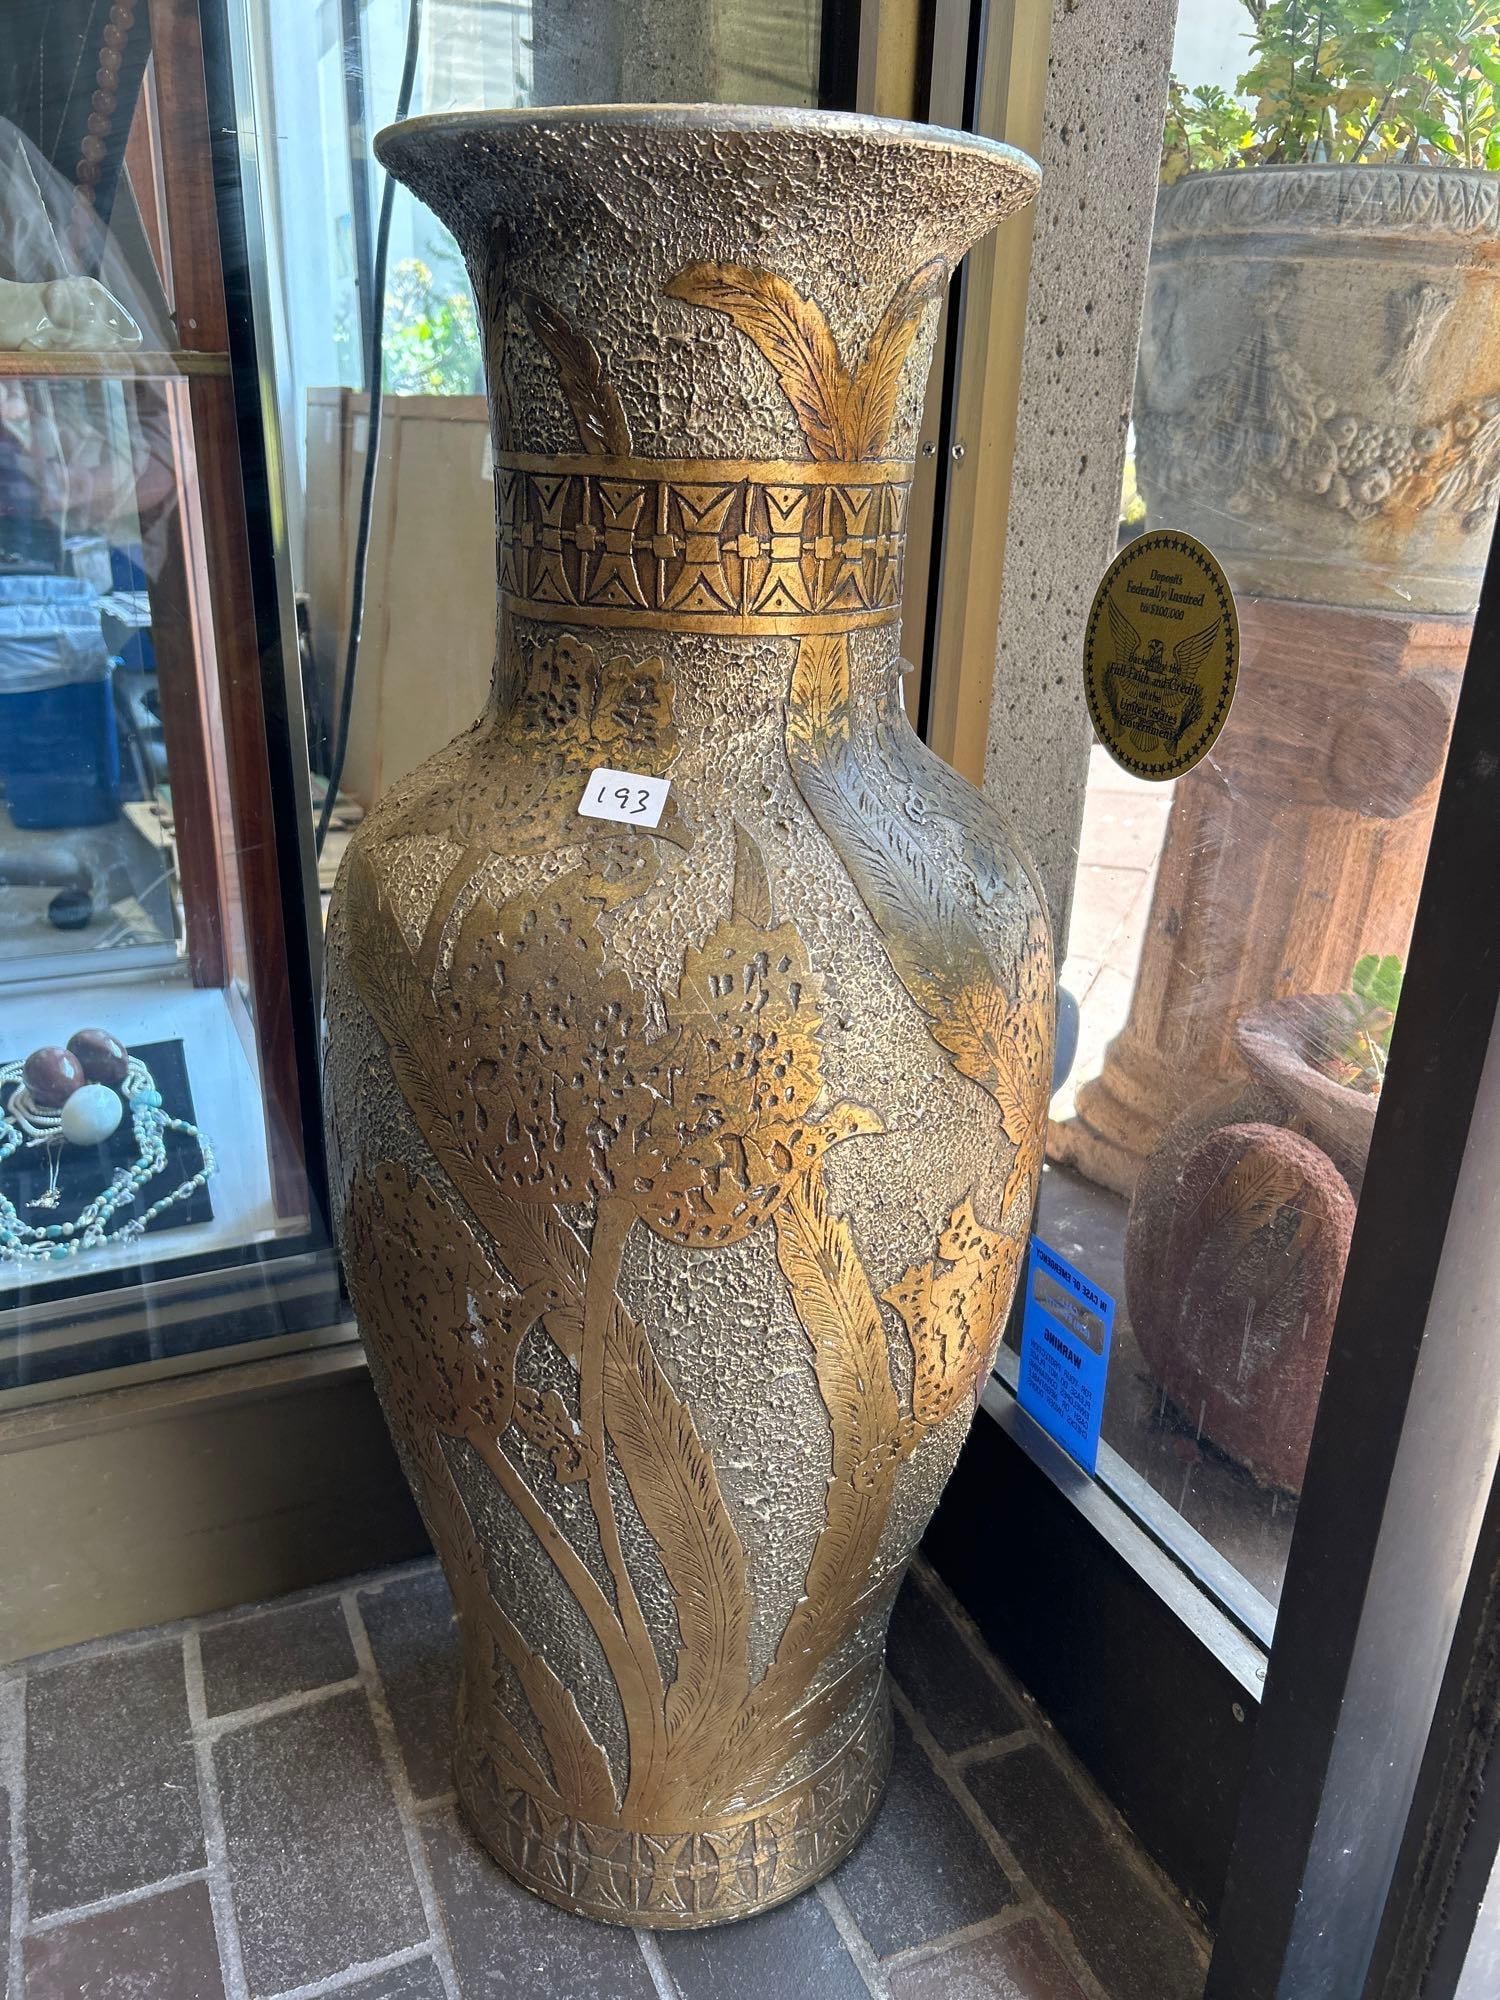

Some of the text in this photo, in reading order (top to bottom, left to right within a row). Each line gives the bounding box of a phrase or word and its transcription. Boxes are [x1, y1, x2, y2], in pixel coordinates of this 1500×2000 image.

[1126, 579, 1206, 607] Federally Insured
[1140, 602, 1185, 620] to $100,000
[1128, 668, 1149, 684] Faith
[1168, 677, 1198, 696] Credit
[1120, 698, 1176, 724] United States
[1119, 714, 1174, 740] Government
[598, 786, 649, 814] 193
